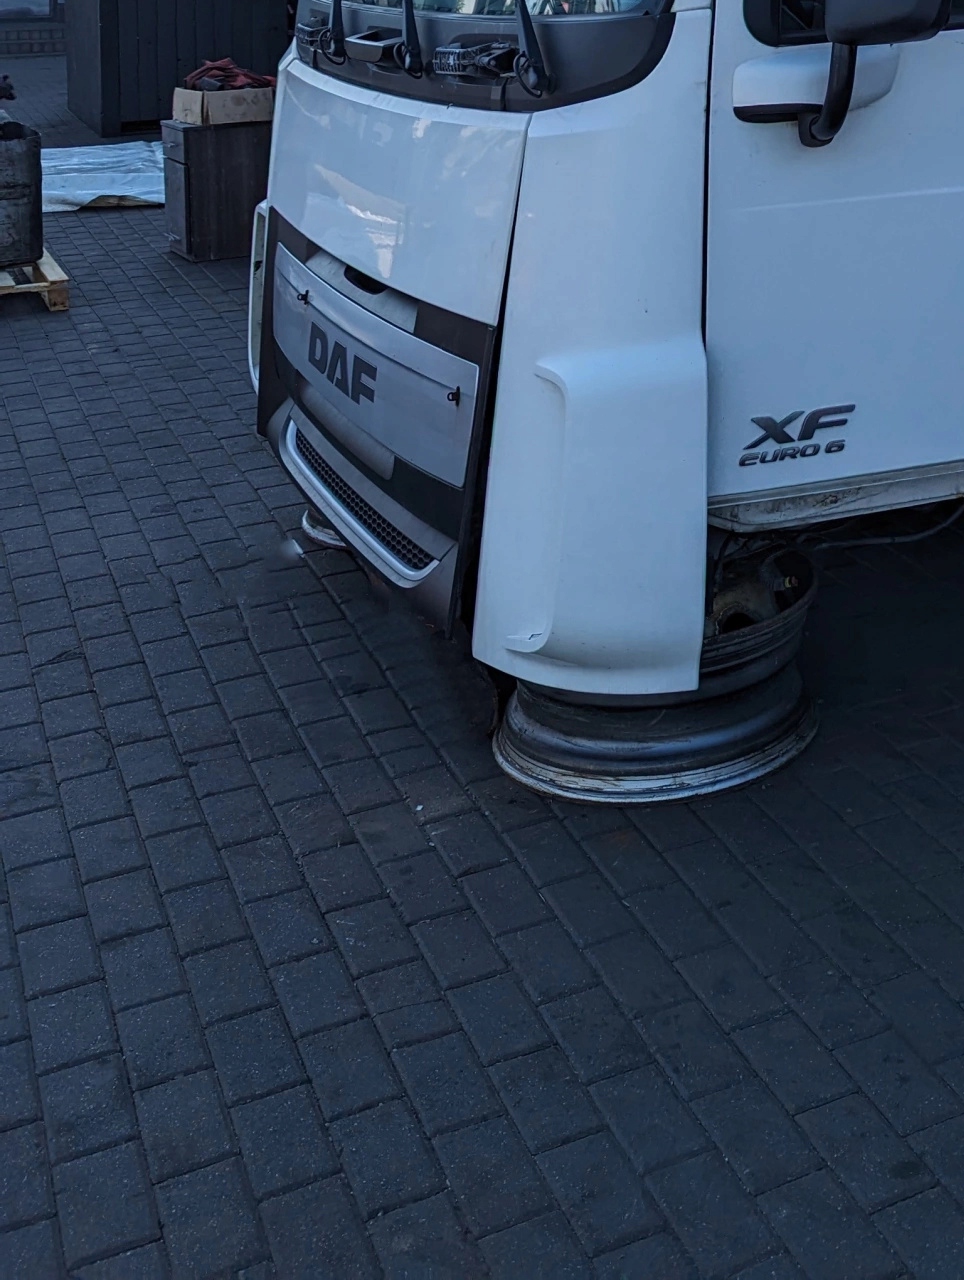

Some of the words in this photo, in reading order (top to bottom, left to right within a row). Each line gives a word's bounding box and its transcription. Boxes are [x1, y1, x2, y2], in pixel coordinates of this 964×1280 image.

[308, 321, 378, 405] DAF
[743, 404, 856, 450] XF
[739, 443, 821, 466] EURO
[825, 439, 846, 454] 6
